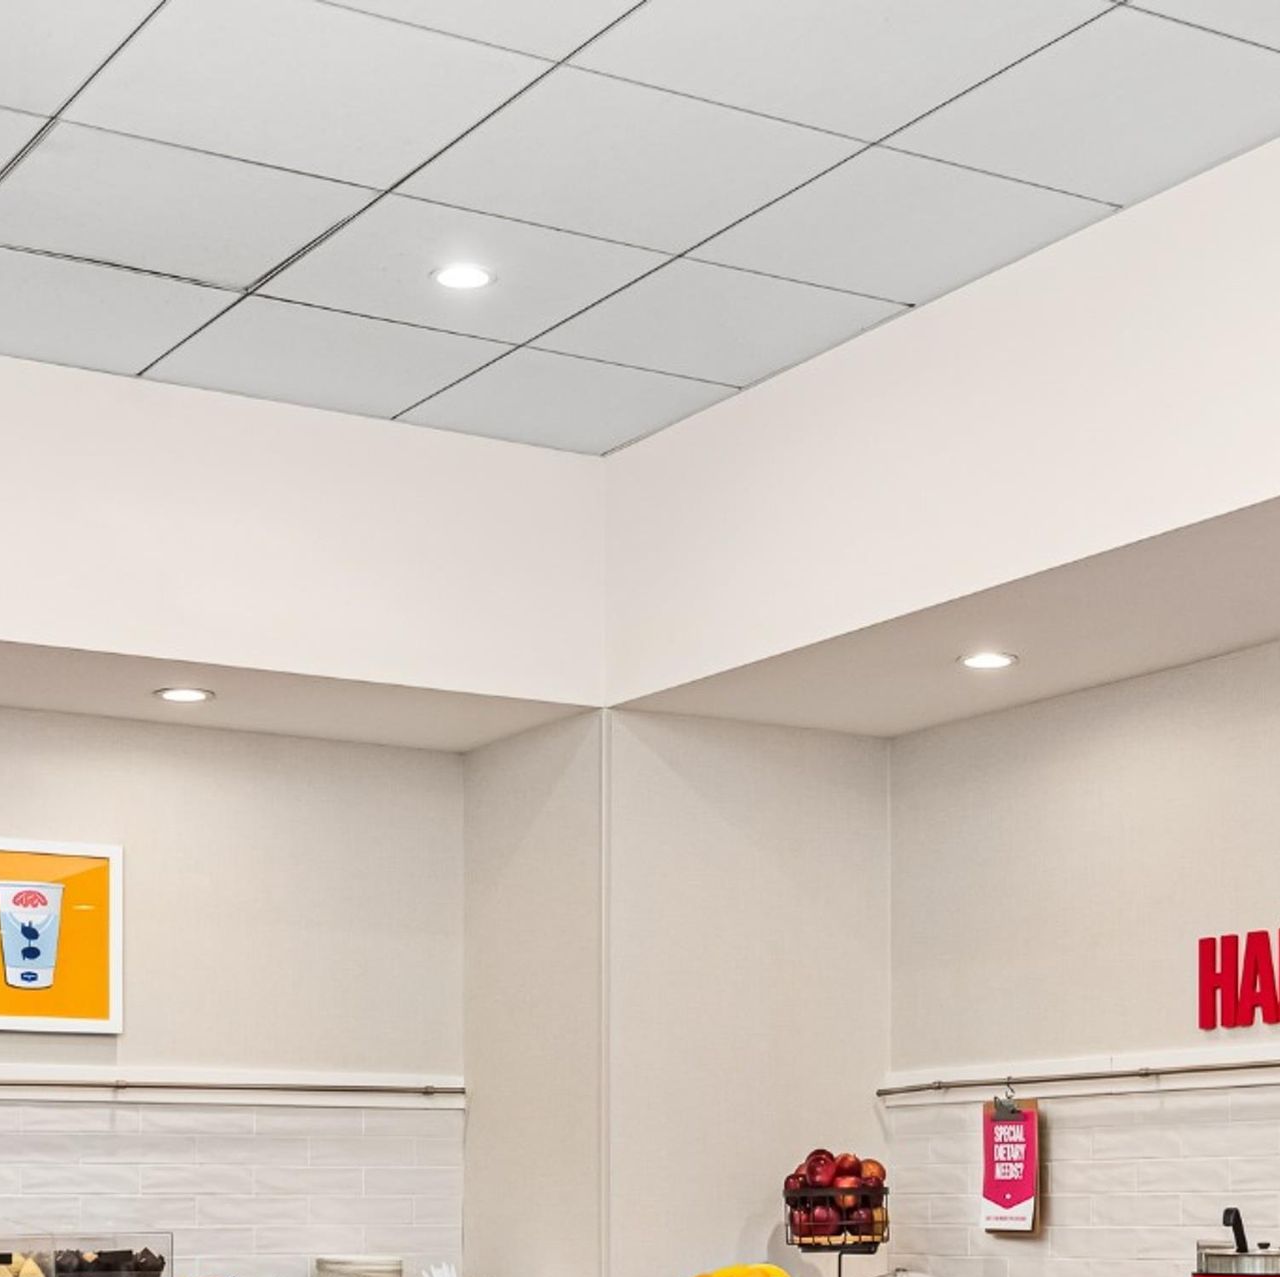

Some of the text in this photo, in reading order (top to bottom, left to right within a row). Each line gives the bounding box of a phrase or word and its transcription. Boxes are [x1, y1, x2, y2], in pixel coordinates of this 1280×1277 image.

[993, 1124, 1026, 1142] SPECIAL
[993, 1143, 1027, 1161] DIETARY
[994, 1162, 1025, 1180] NEEDS?
